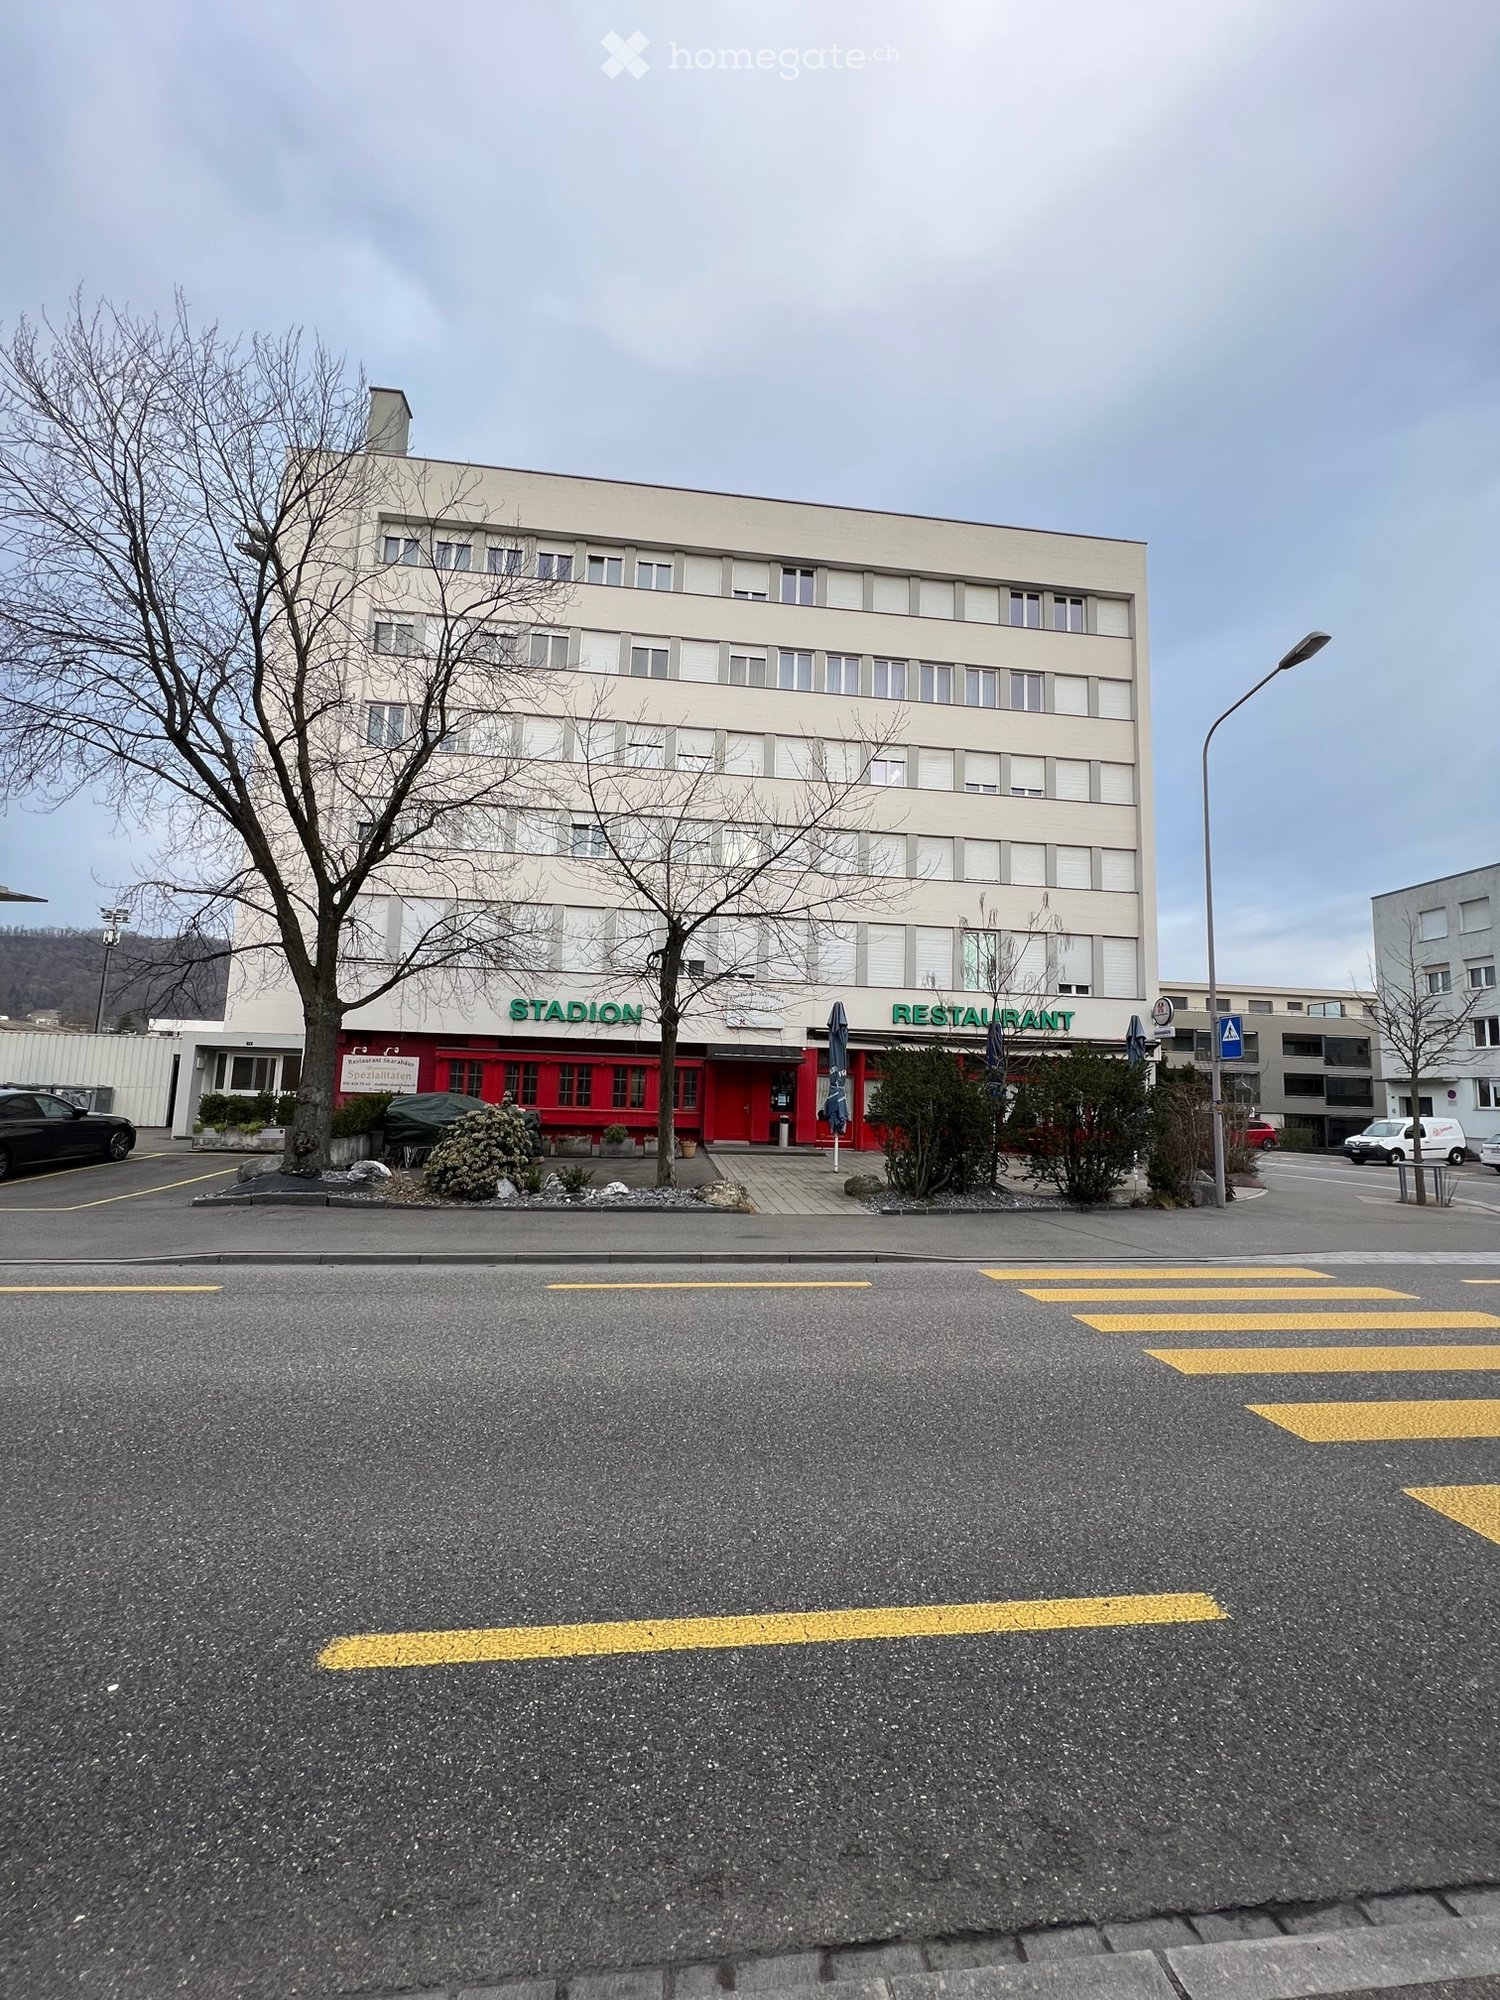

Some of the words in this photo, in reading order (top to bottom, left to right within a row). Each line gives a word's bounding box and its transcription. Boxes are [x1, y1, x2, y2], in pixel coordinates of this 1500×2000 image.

[509, 998, 643, 1025] STADION
[892, 1003, 1076, 1031] RESTAURANT
[347, 1057, 382, 1065] Restaurant
[347, 1069, 412, 1081] Spezialitäten
